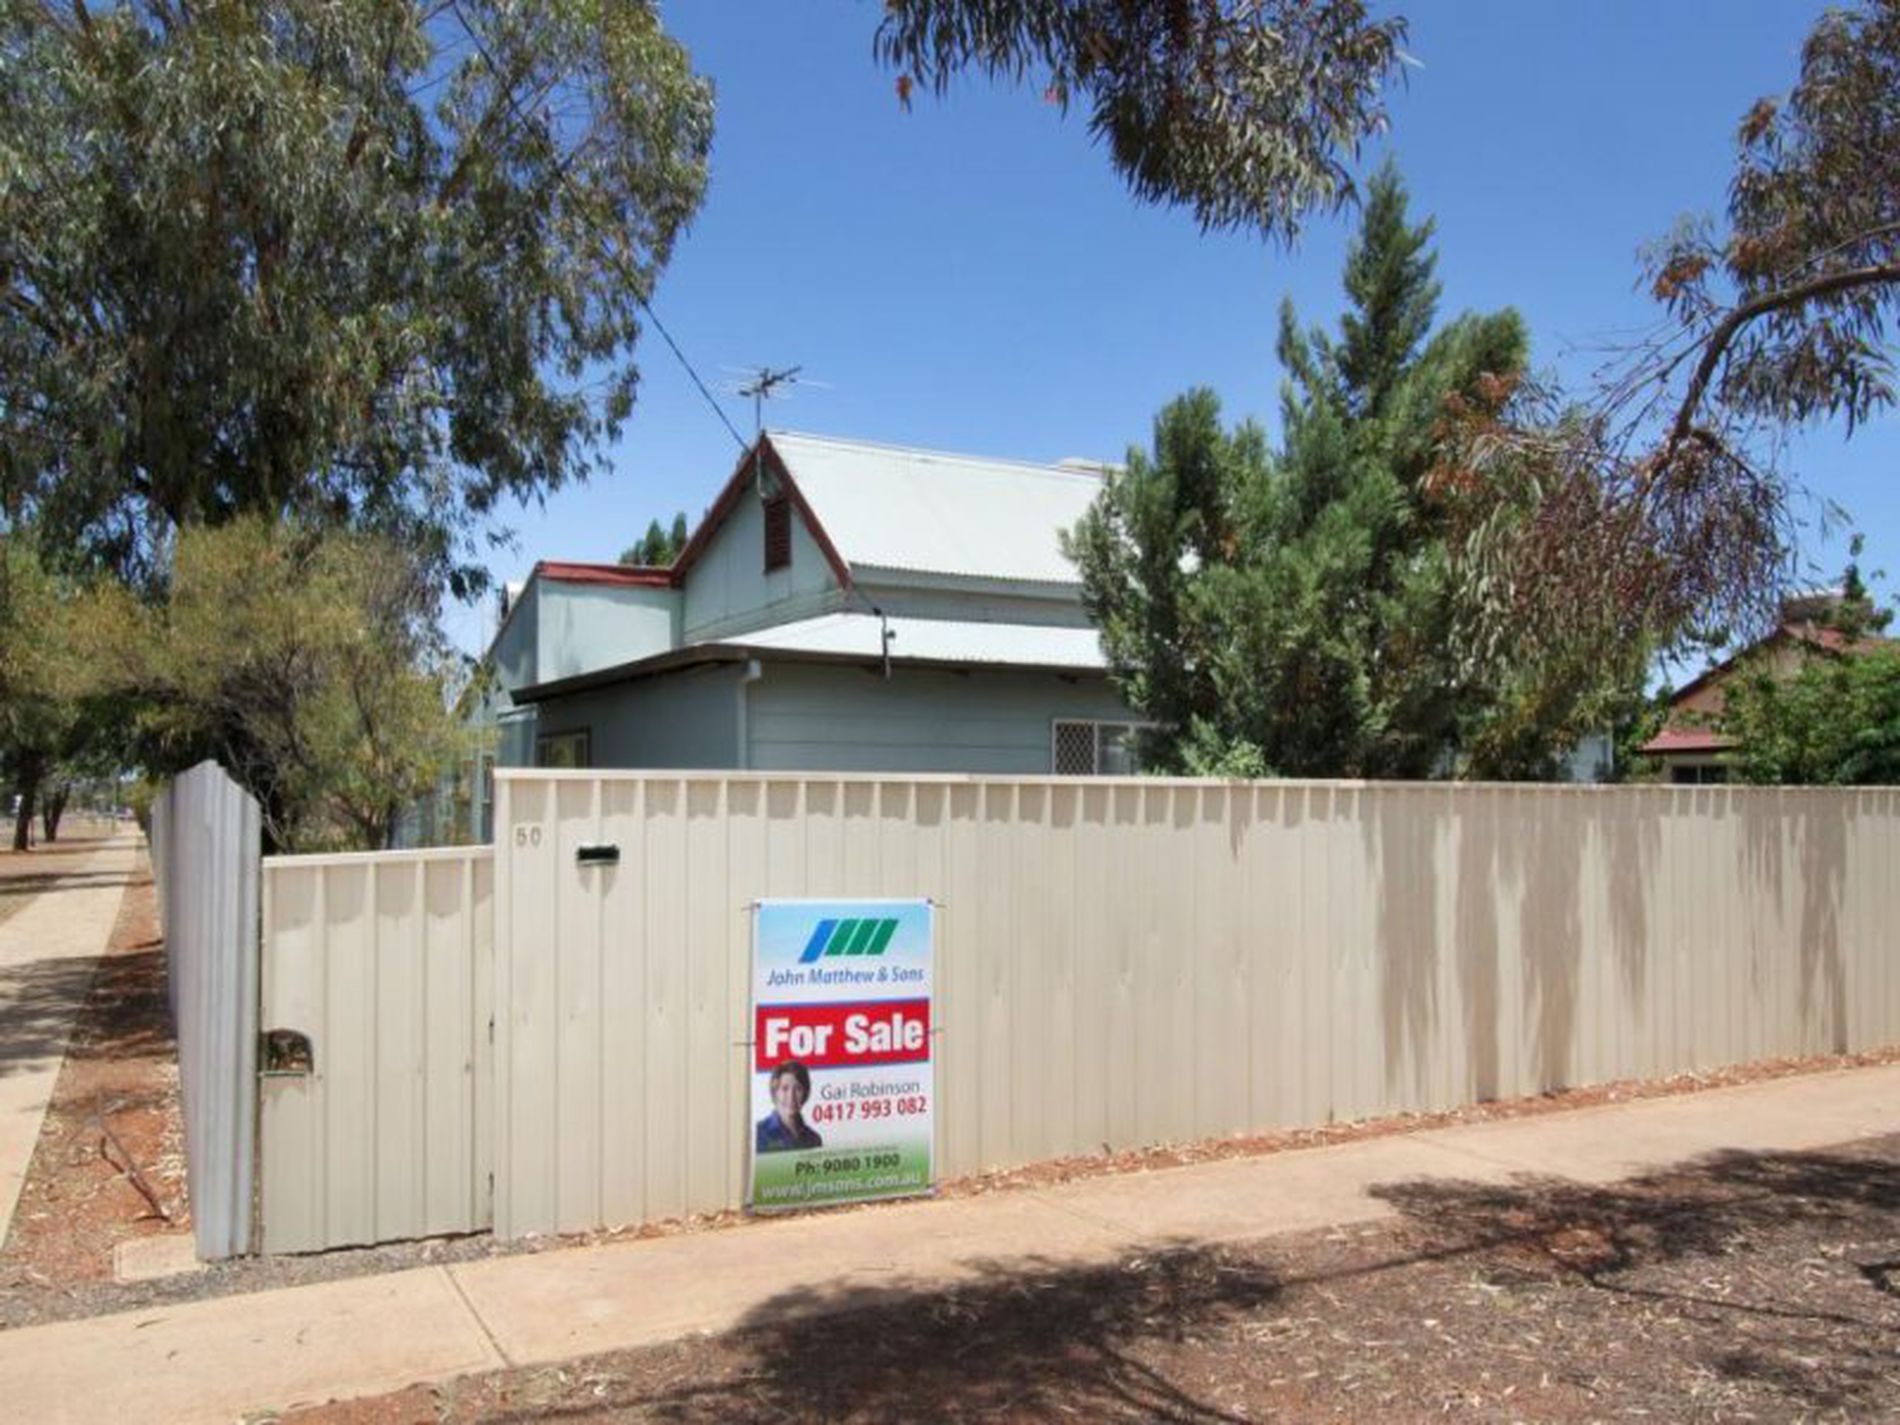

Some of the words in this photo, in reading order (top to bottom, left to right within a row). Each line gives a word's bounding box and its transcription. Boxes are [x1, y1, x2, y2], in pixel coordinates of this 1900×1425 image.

[767, 970, 805, 986] John
[808, 967, 874, 985] Matthew
[876, 967, 888, 982] &
[891, 967, 924, 983] Sons
[765, 1017, 833, 1058] For
[844, 1013, 924, 1056] Sale
[851, 1080, 920, 1097] Robinson
[812, 1102, 855, 1123] 0417
[860, 1099, 892, 1119] 993
[897, 1096, 927, 1115] 082
